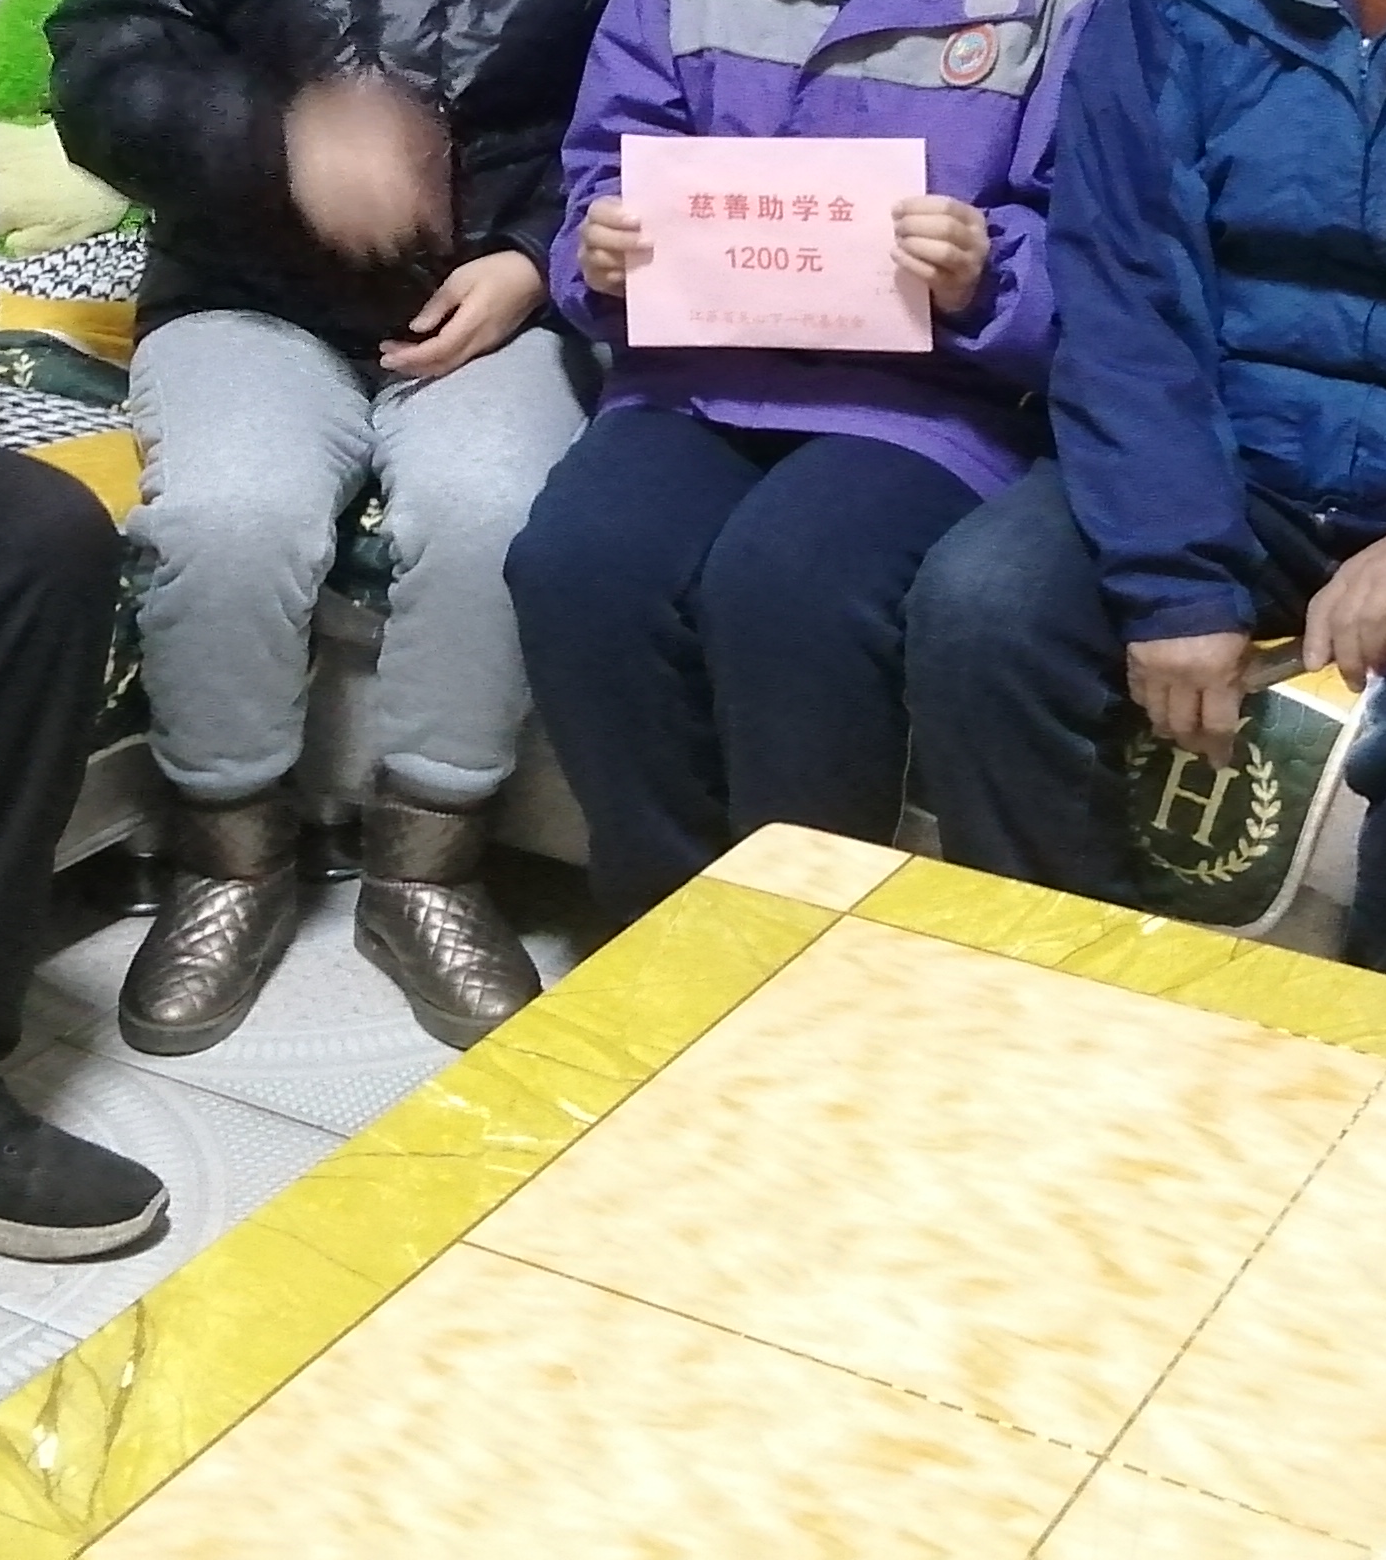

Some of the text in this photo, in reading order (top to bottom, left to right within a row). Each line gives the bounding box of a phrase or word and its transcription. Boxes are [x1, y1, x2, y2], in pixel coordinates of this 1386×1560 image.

[688, 192, 855, 223] 慈善助学金
[725, 245, 824, 273] 1200元
[1150, 746, 1242, 849] H
